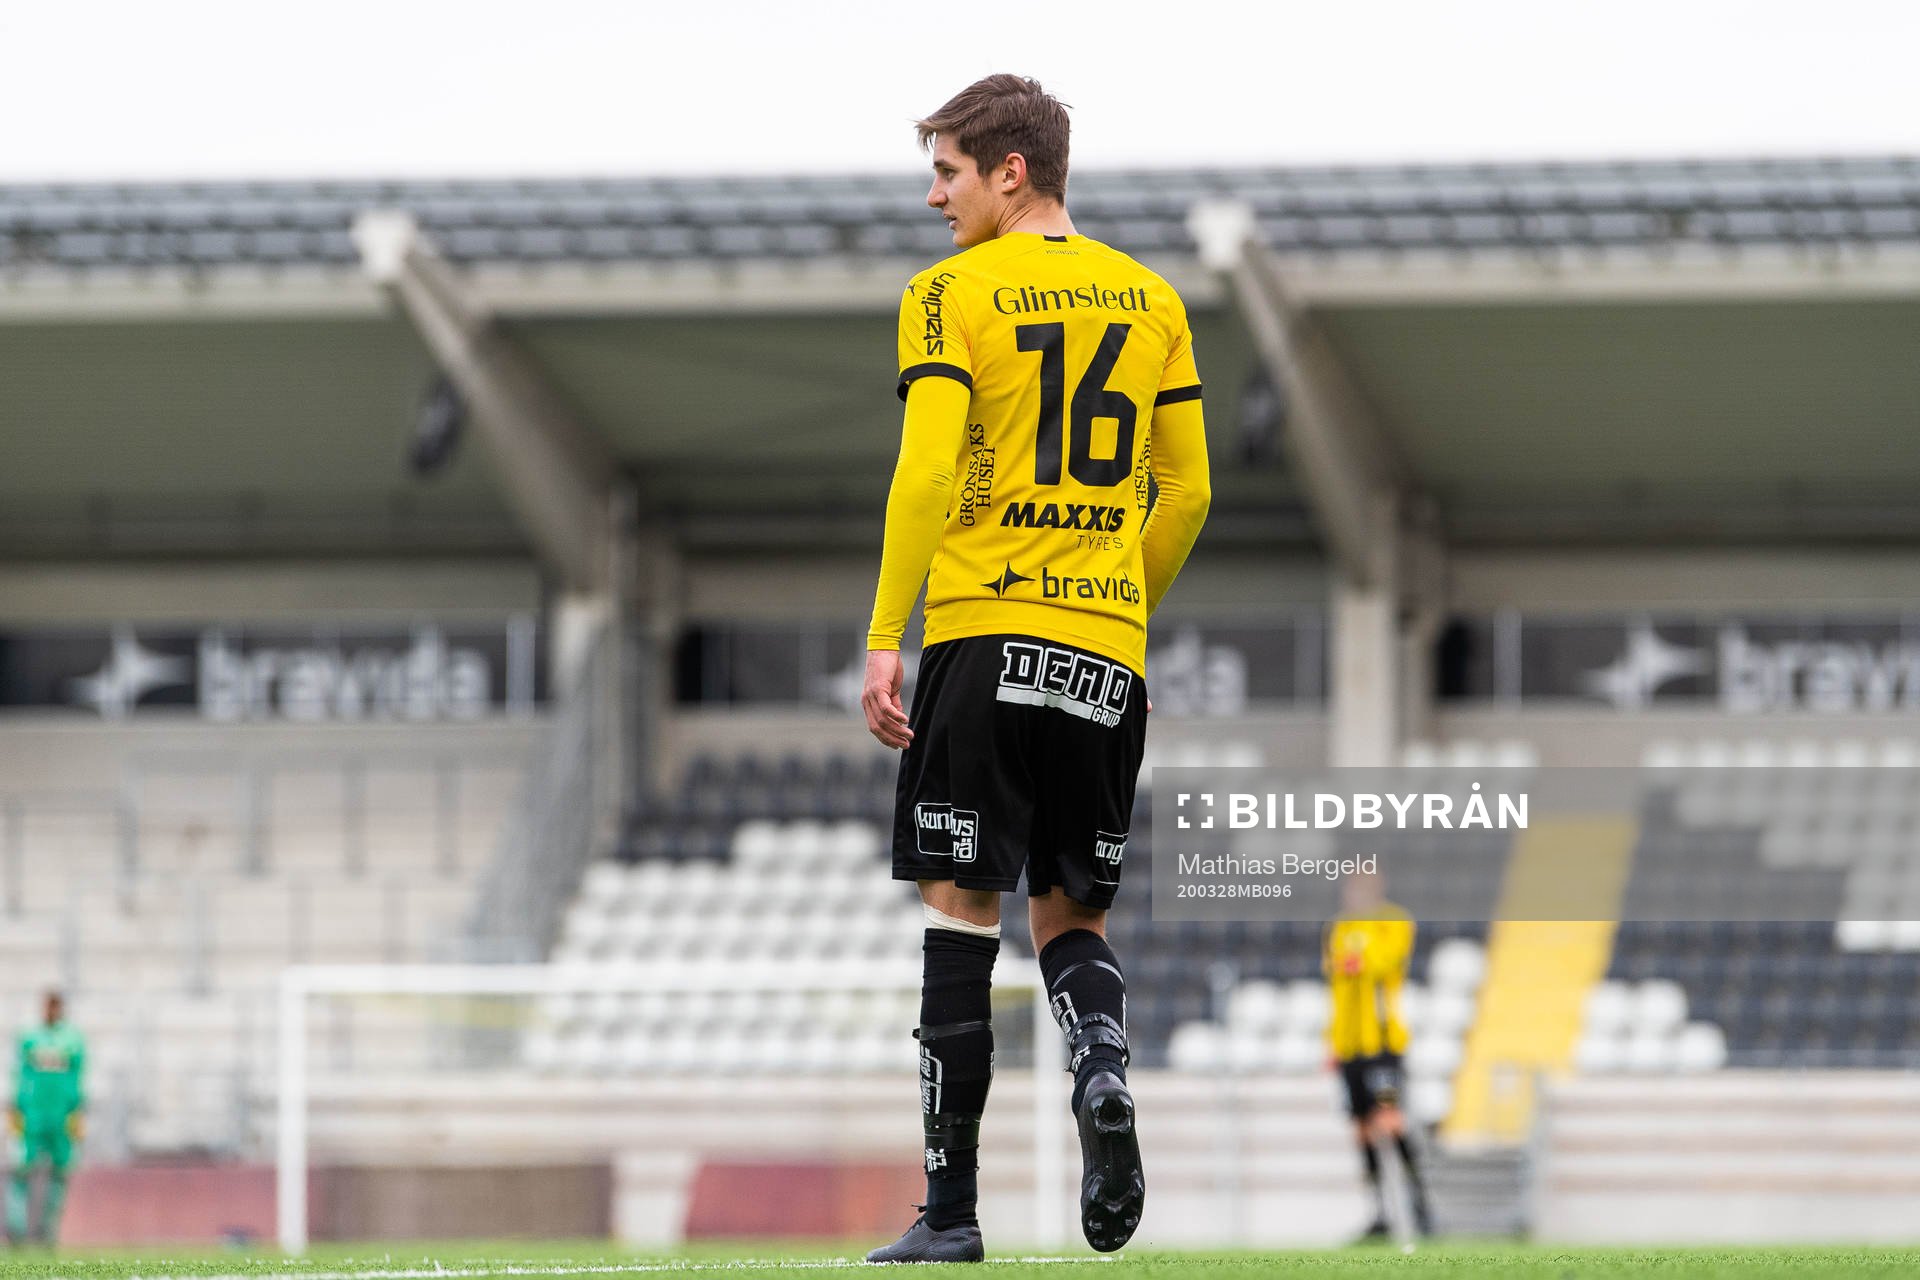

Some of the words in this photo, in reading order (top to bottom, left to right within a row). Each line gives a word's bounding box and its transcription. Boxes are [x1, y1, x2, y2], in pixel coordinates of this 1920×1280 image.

[921, 272, 956, 356] stadium
[993, 283, 1151, 315] Glimstedt
[1015, 322, 1138, 487] 16
[960, 423, 985, 527] GRÖNSAKS
[976, 446, 996, 509] HUSET
[1000, 502, 1126, 532] MAXXIS
[1076, 535, 1124, 550] TYRES
[1042, 567, 1141, 606] bravida
[1000, 641, 1133, 715] DEMO
[1092, 707, 1121, 729] GRUP
